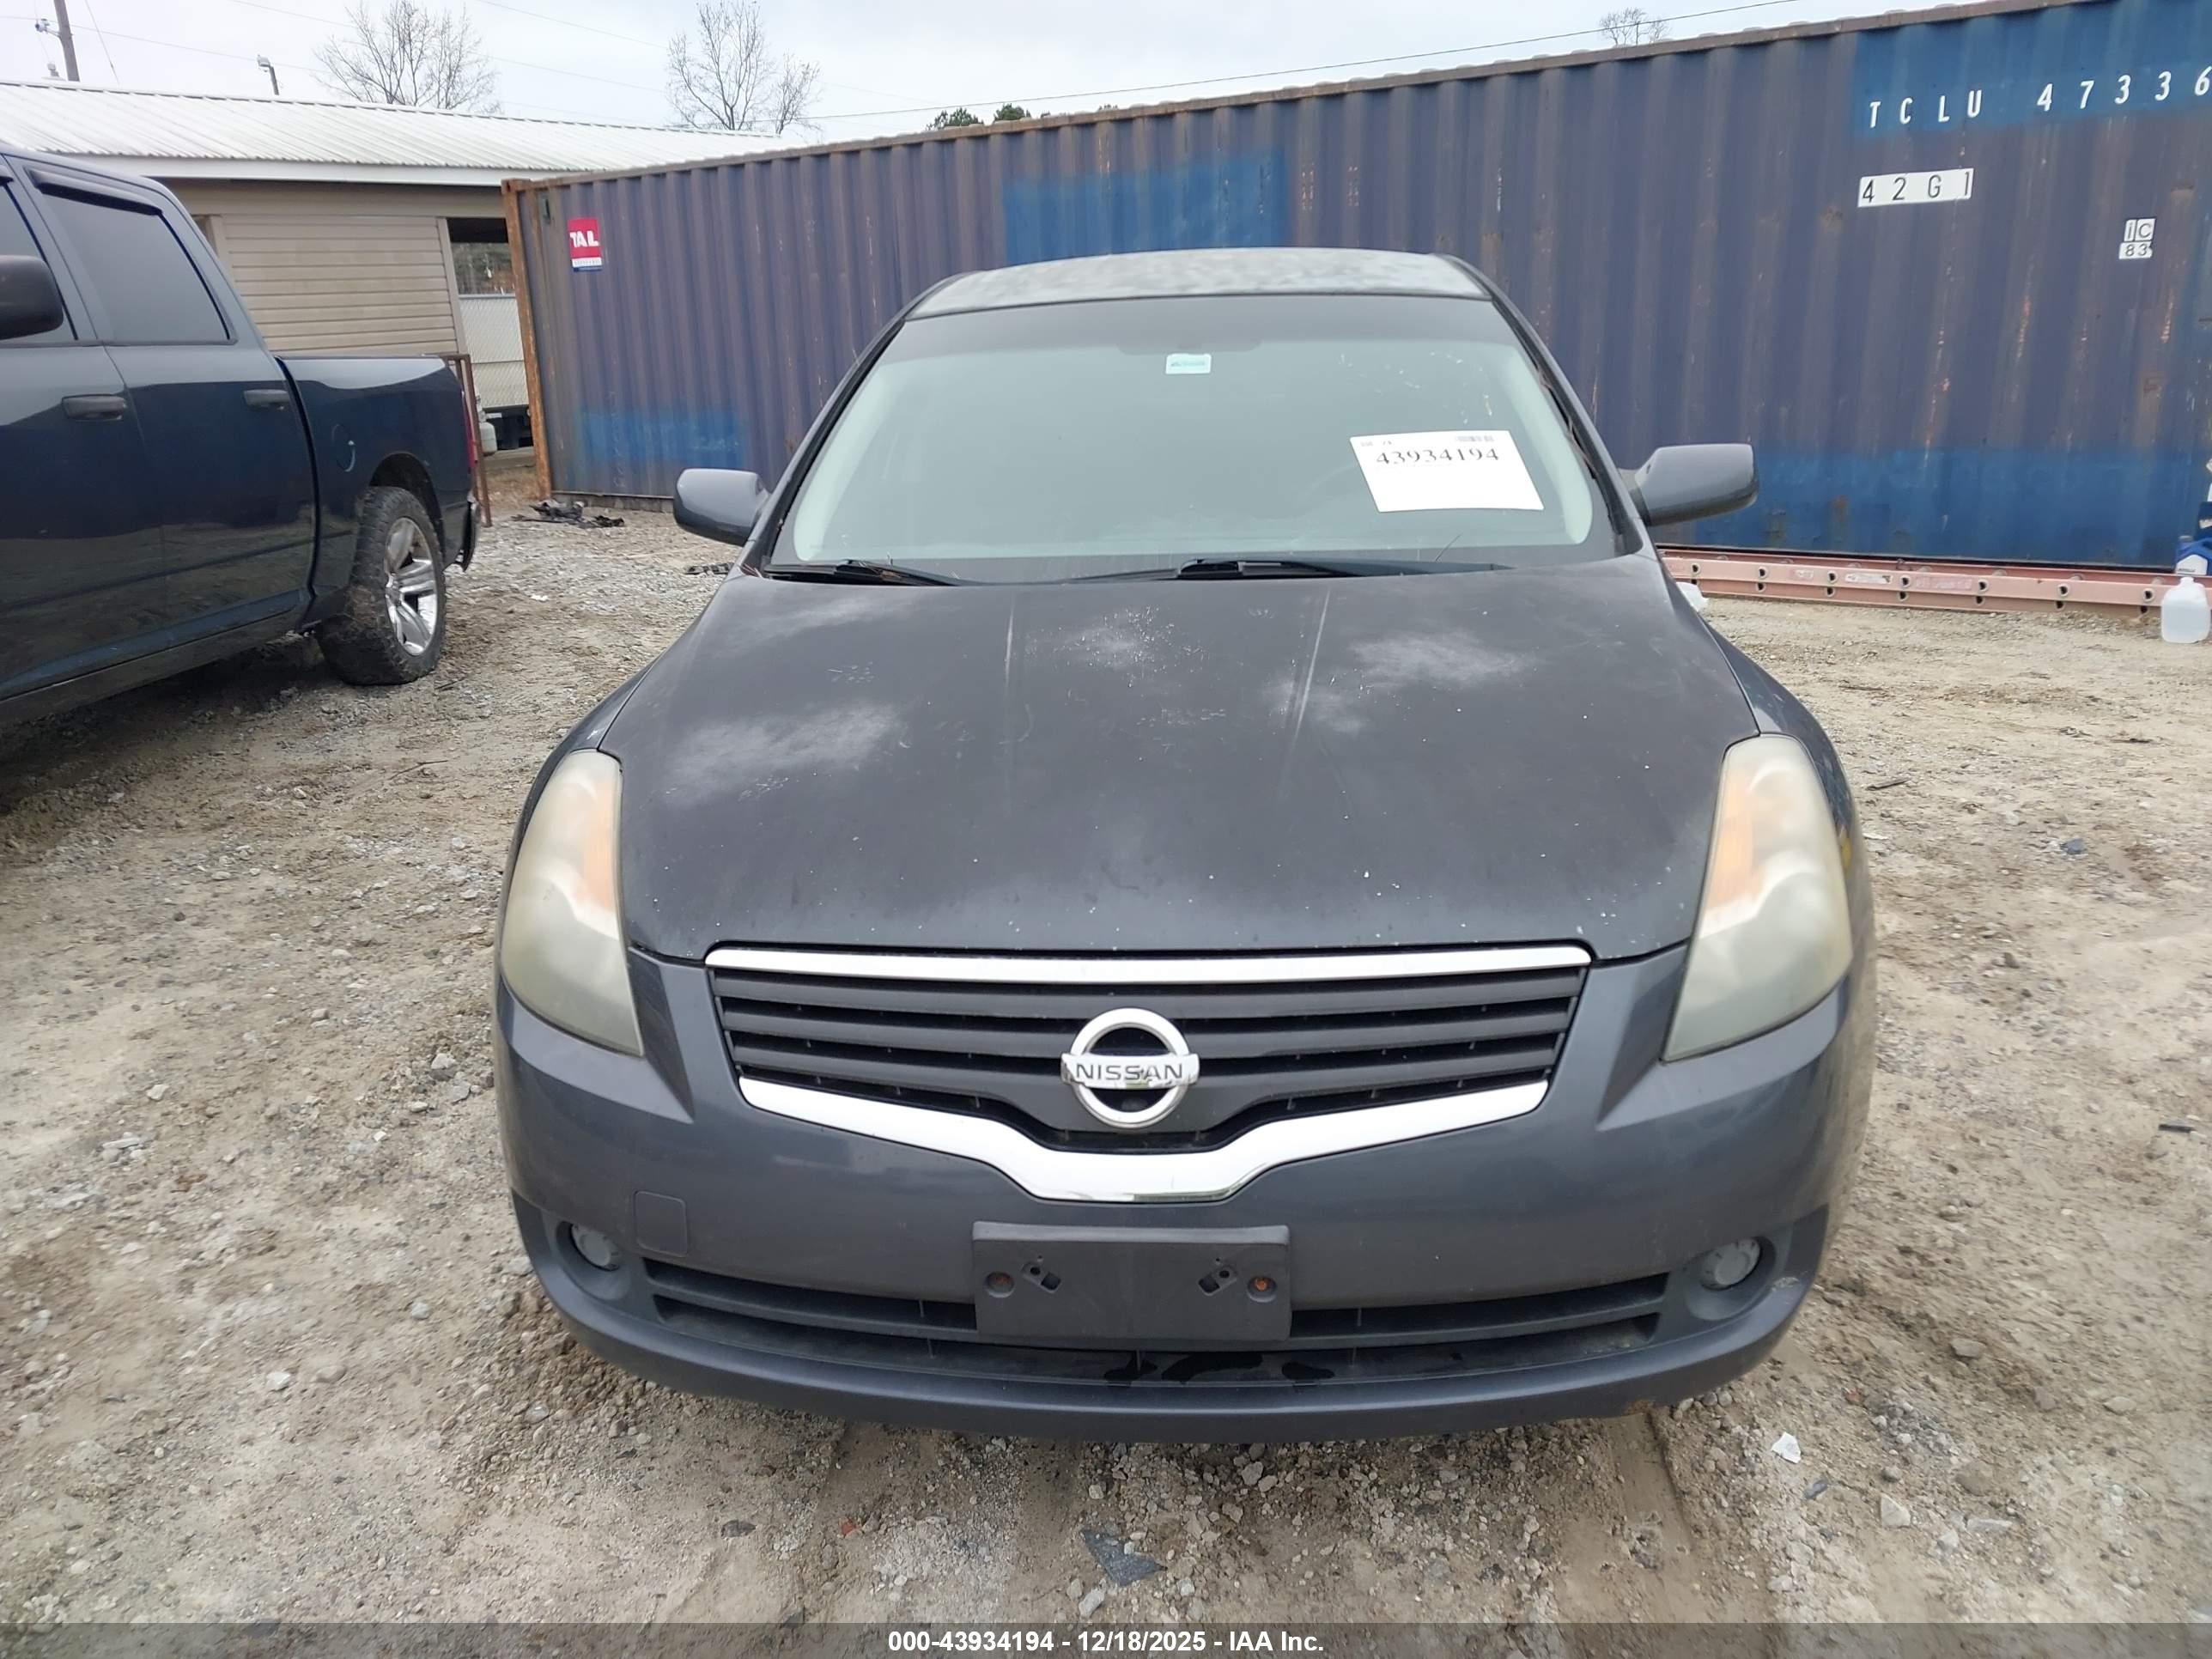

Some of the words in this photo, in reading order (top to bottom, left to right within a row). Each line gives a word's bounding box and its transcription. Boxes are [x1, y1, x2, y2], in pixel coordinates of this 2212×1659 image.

[1869, 89, 1982, 128] TCLU
[2037, 65, 2212, 112] 47336
[1862, 171, 1971, 203] 42G1
[569, 230, 599, 247] TAL
[2125, 243, 2148, 256] 83
[1376, 447, 1499, 465] 43934194
[1076, 1063, 1182, 1080] NISSAN
